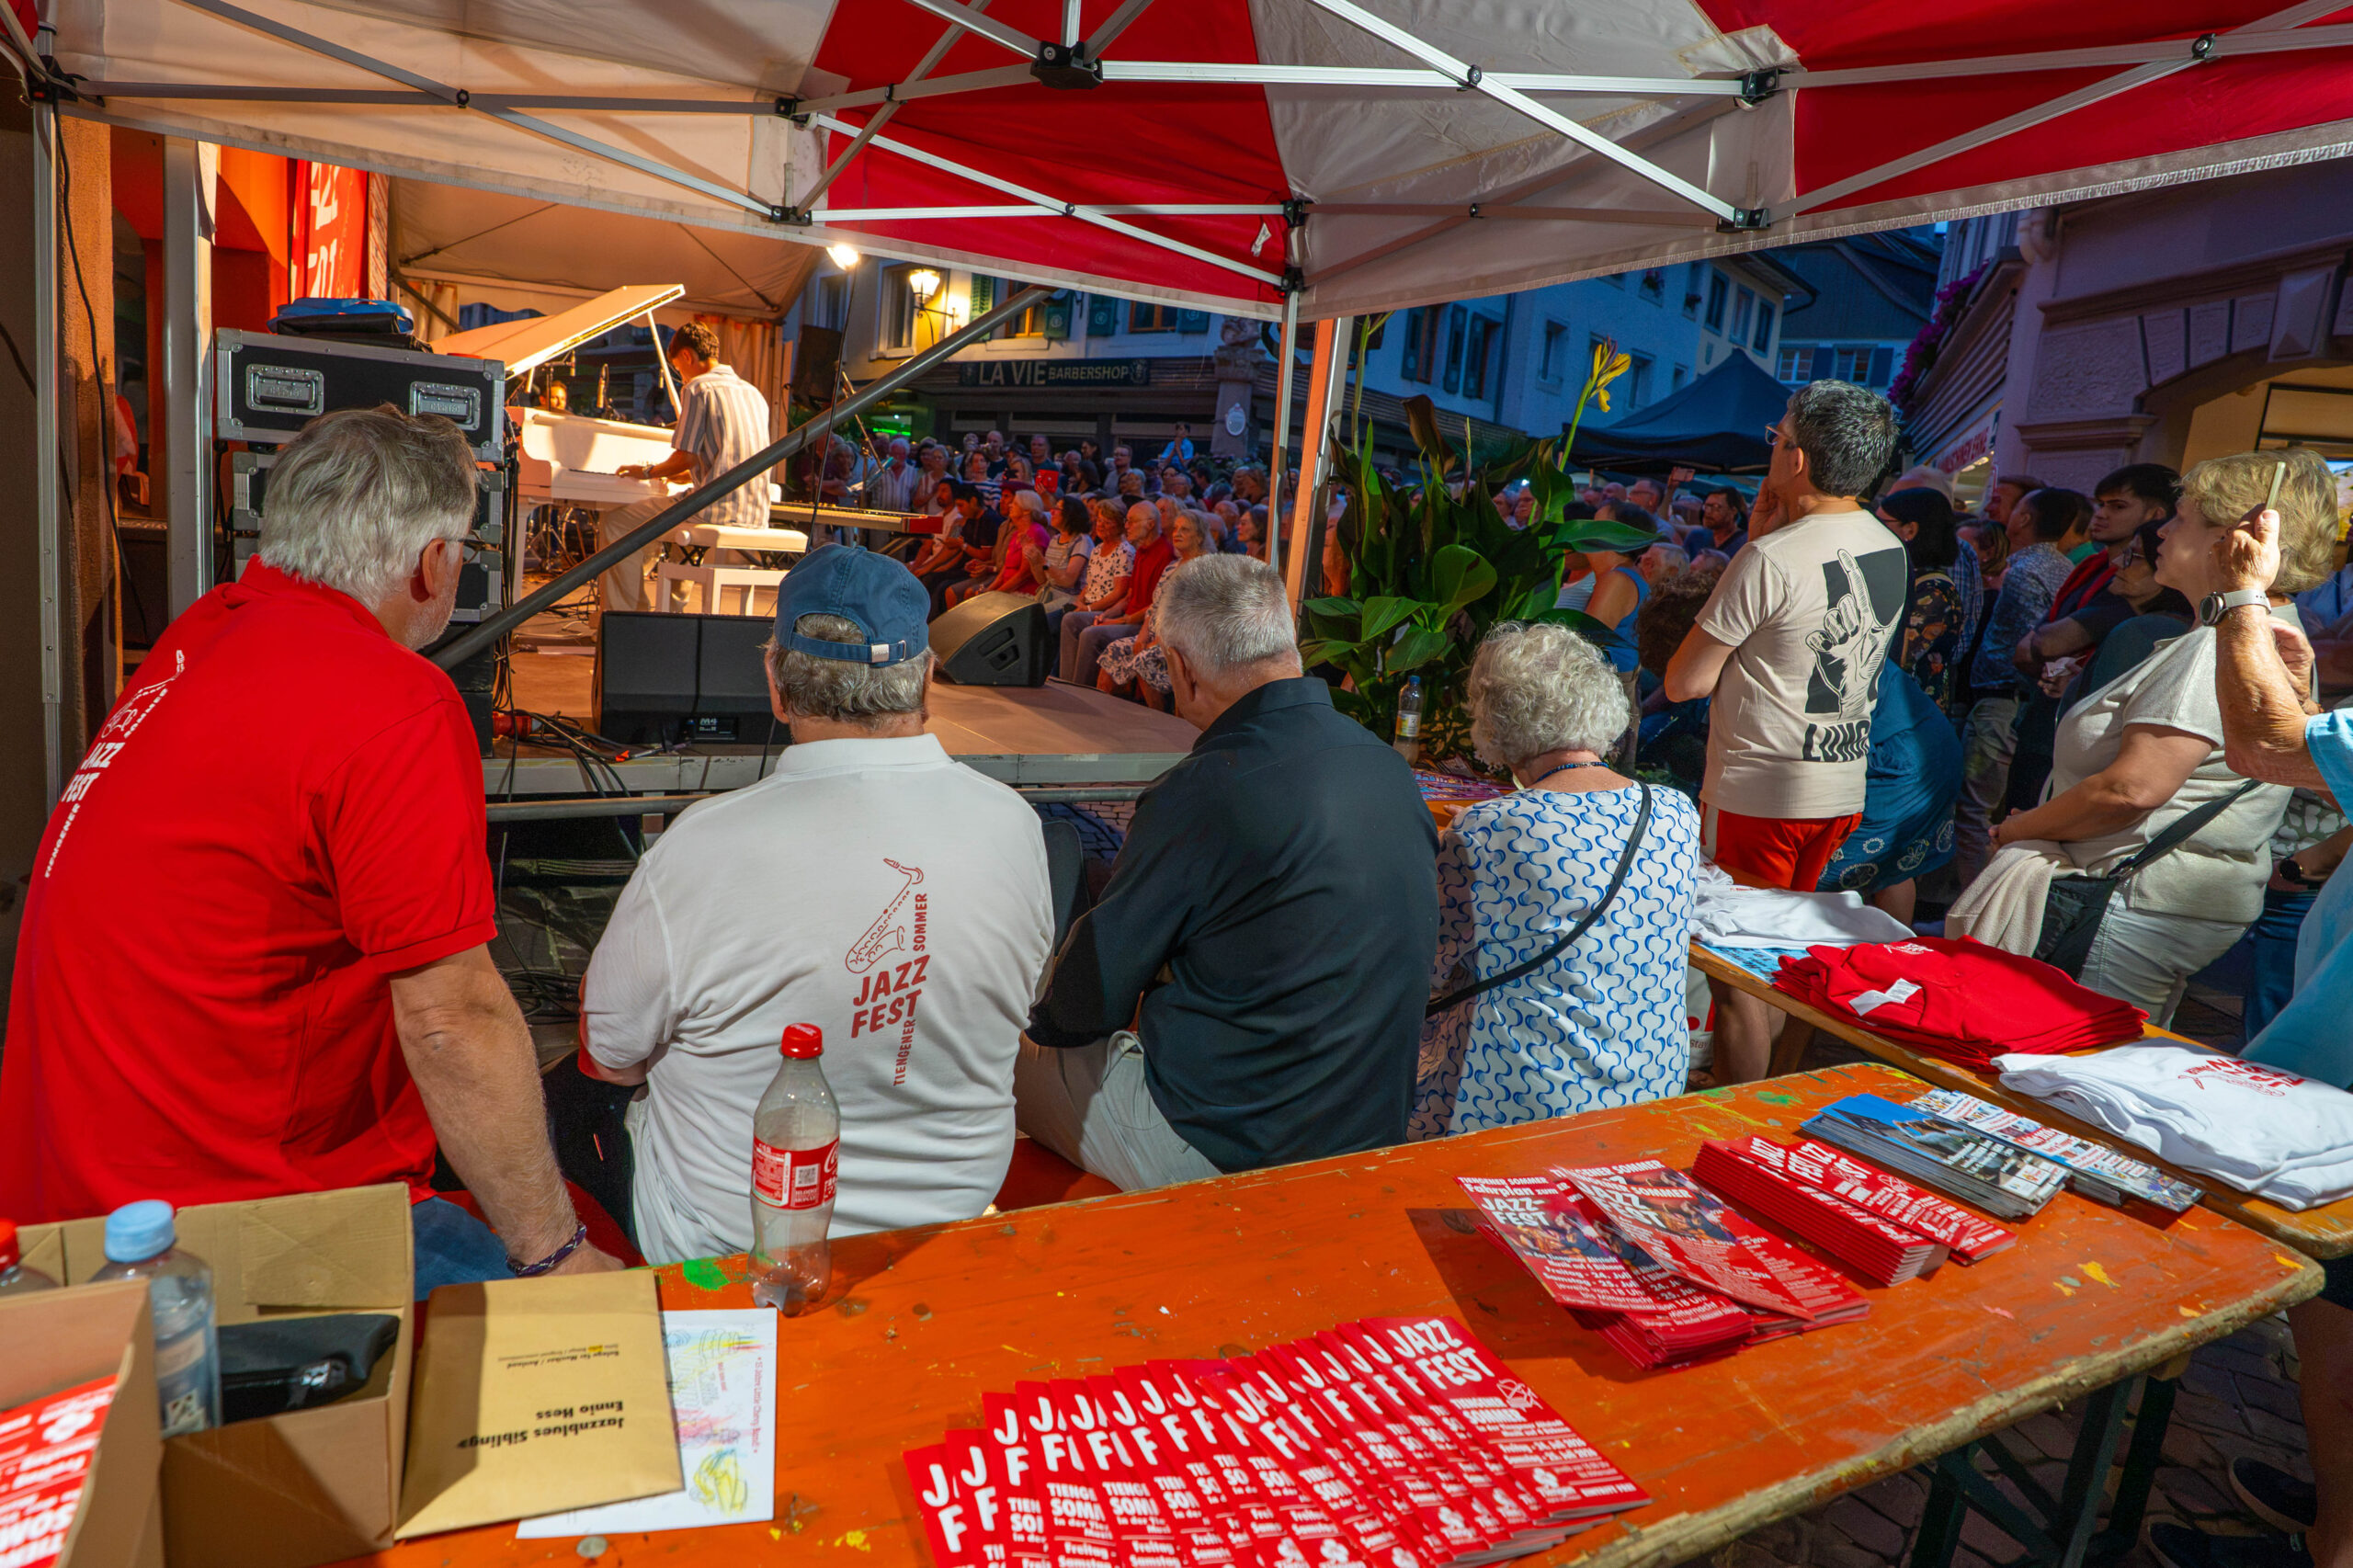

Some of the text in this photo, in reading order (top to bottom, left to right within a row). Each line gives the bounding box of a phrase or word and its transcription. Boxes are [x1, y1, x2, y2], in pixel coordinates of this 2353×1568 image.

[978, 360, 1129, 385] LA VIE BARBERSHOP
[80, 742, 127, 770] JAZZ
[61, 772, 100, 802] FEST
[913, 892, 927, 952] SOMMER
[852, 954, 931, 1007] JAZZ
[850, 988, 923, 1040] FEST
[892, 1017, 916, 1087] TIENGENER
[1612, 1159, 1666, 1175] SOMMER
[1458, 1176, 1549, 1186] TIENGENER SOMMER
[1464, 1183, 1535, 1198] Fahrplan
[1630, 1187, 1693, 1199] SOMMER
[1481, 1198, 1545, 1211] JAZZ-
[1492, 1211, 1551, 1227] FEST
[1542, 1272, 1592, 1287] Samstag
[1620, 1279, 1640, 1288] Juli
[1544, 1266, 1584, 1278] Freitag
[1689, 1295, 1708, 1304] Uhr
[1386, 1319, 1463, 1358] JAZZ
[1415, 1346, 1495, 1390] FEST
[536, 1401, 624, 1420] Ennio Hess
[1462, 1408, 1528, 1424] SOMMER
[534, 1417, 625, 1437] Jazznblues
[1498, 1444, 1533, 1454] Freitag
[1504, 1454, 1544, 1464] Samstag
